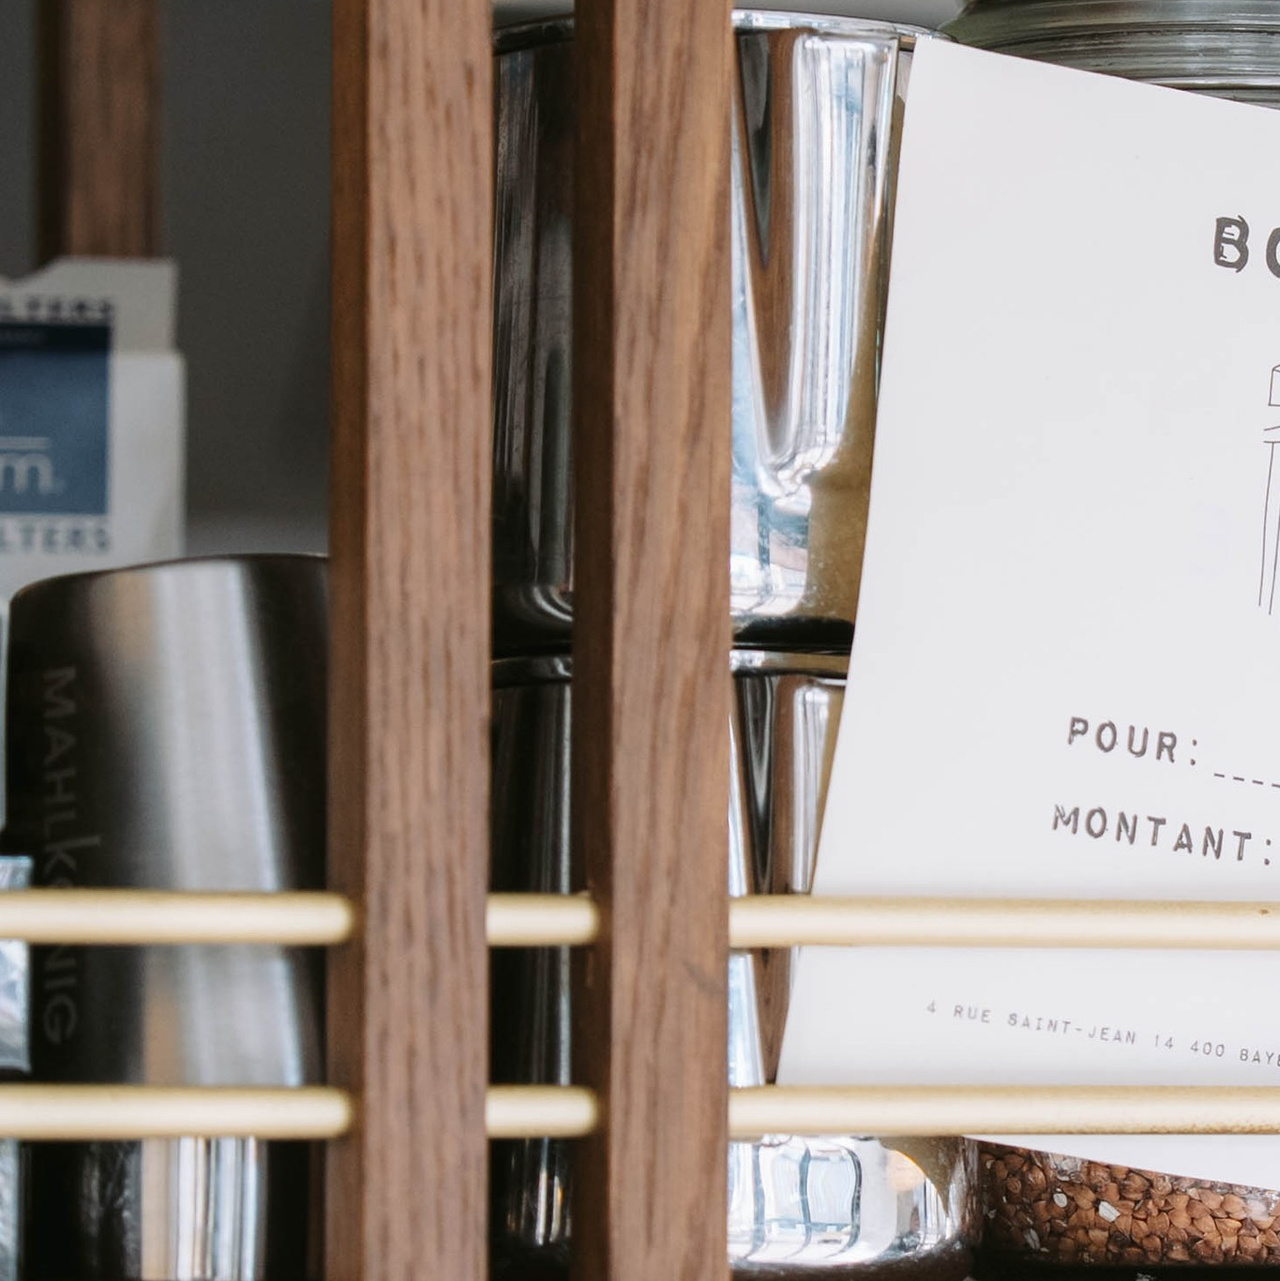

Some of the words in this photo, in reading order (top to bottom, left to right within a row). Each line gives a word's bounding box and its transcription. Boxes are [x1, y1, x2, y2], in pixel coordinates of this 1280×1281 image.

[1067, 716, 1198, 766] POUR:
[1052, 804, 1272, 866] MONTANT:
[926, 1000, 937, 1014] 4
[953, 1004, 992, 1024] RUE
[1007, 1012, 1136, 1045] SAINT-JEAN
[1154, 1034, 1174, 1050] 14
[1189, 1039, 1226, 1058] 400
